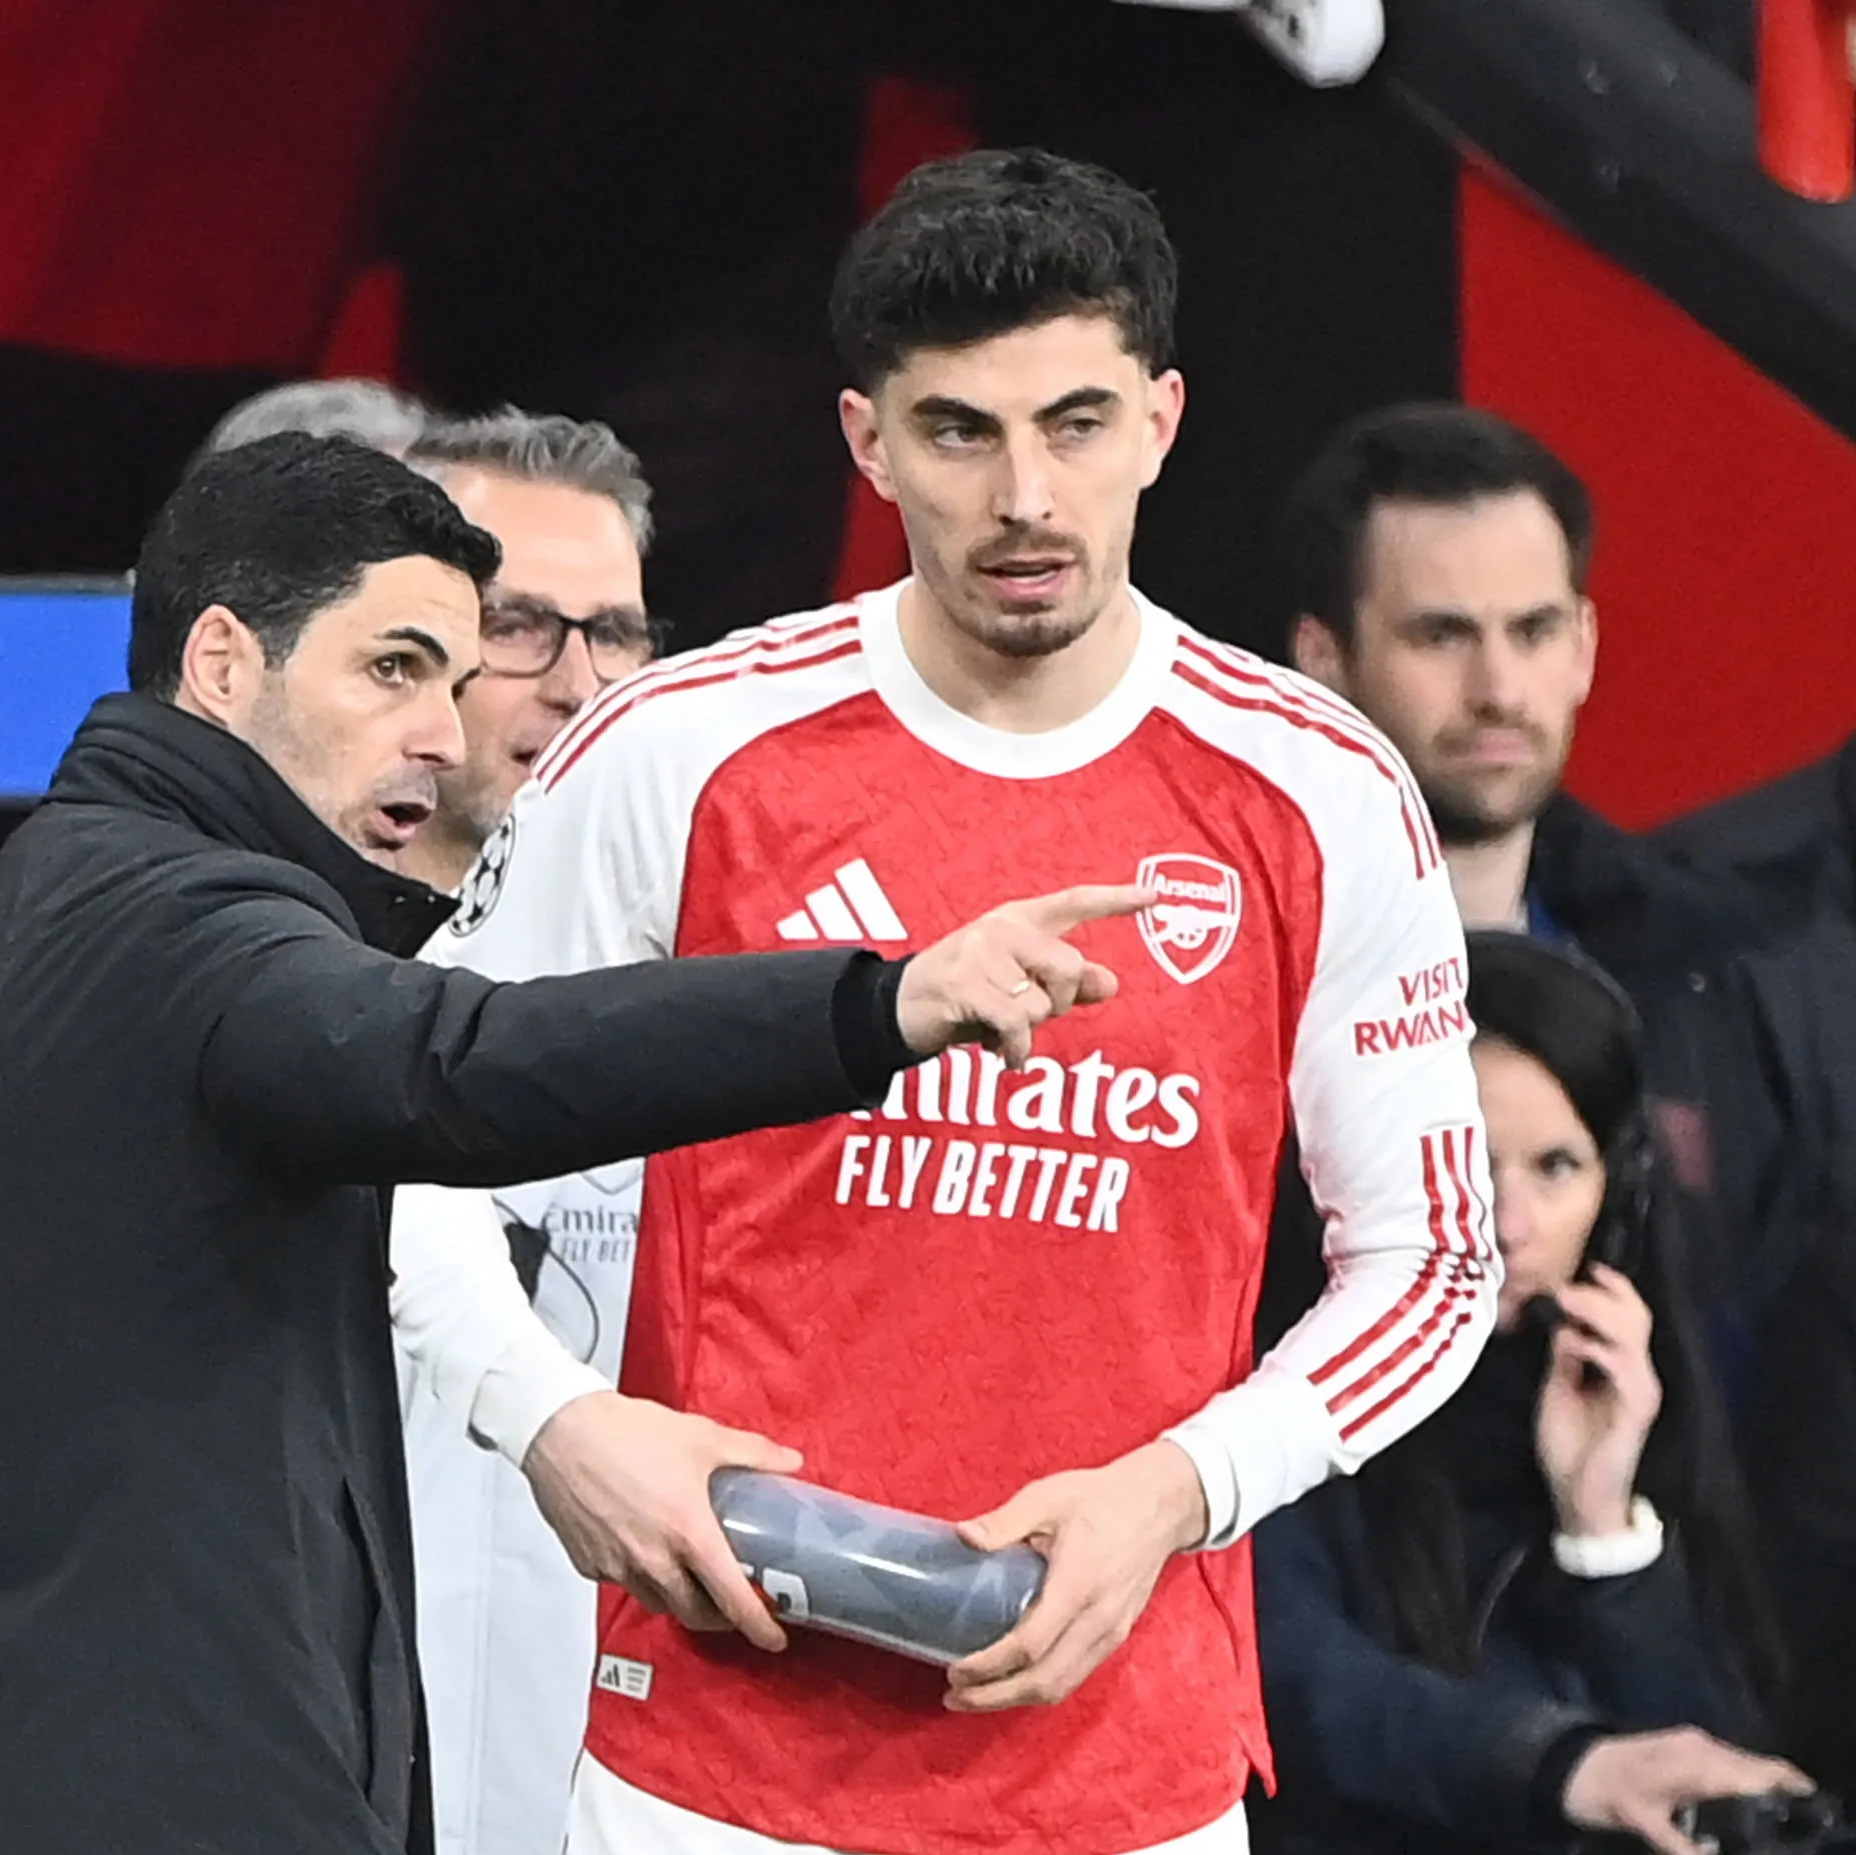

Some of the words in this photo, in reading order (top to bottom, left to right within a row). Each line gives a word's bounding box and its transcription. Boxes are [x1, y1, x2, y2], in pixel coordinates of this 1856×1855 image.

[1398, 957, 1464, 1007] VISIT
[834, 1134, 933, 1209] FLY
[931, 1139, 1131, 1234] BETTER
